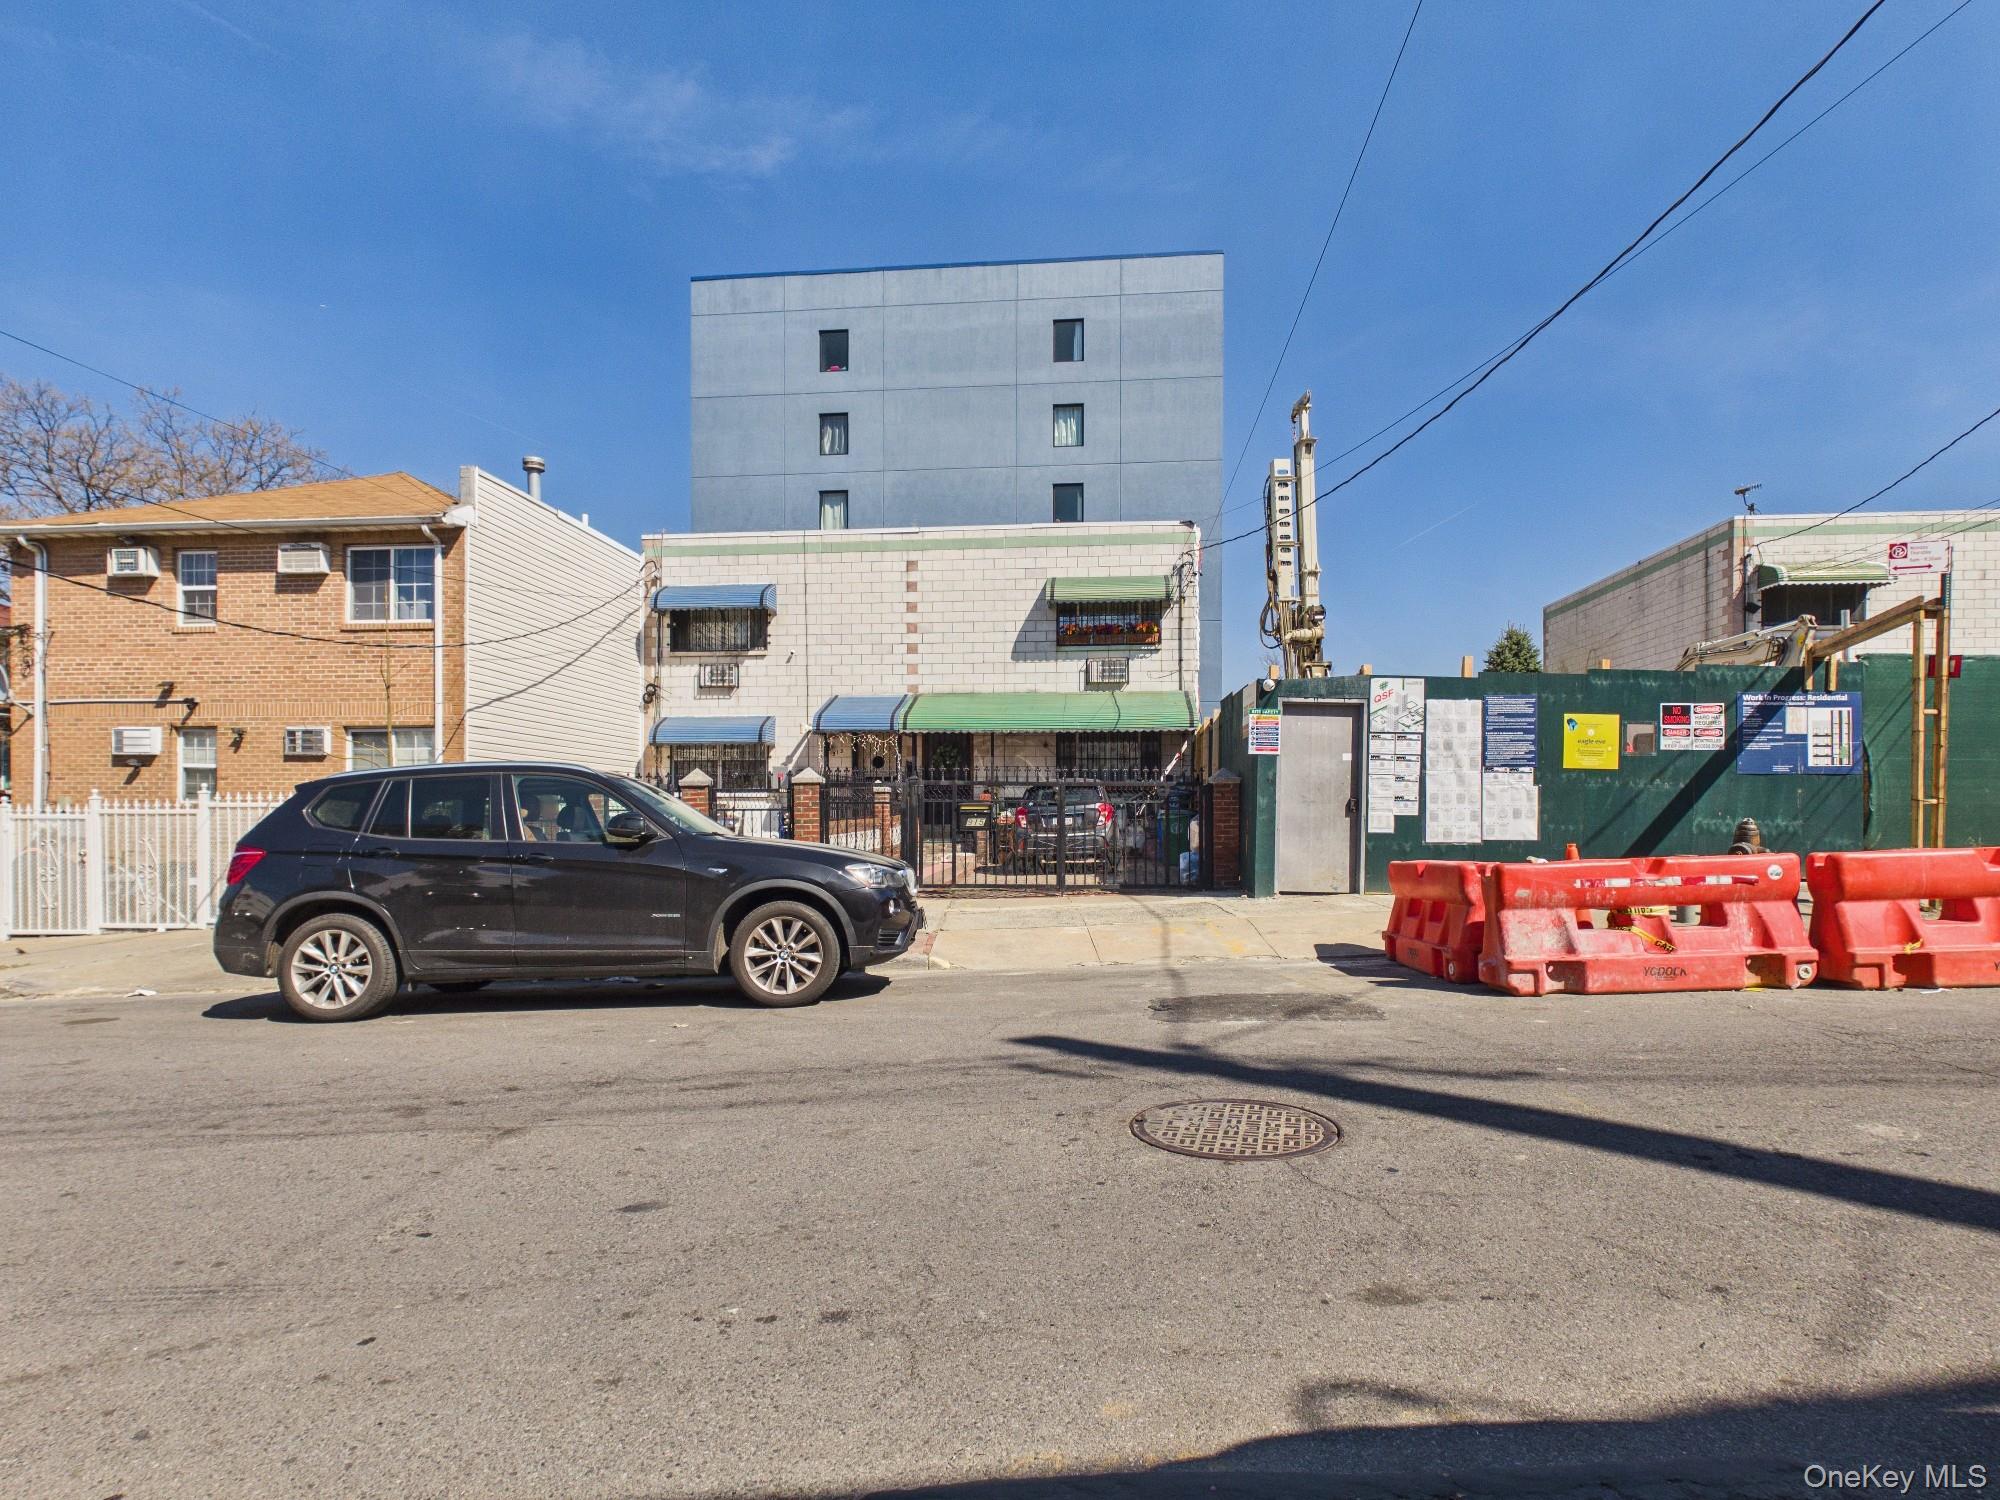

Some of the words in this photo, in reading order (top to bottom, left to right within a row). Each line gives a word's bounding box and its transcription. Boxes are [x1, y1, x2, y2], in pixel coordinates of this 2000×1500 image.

[1773, 694, 1807, 702] Progress:
[1672, 706, 1682, 715] NO
[1663, 715, 1690, 724] SMOKING
